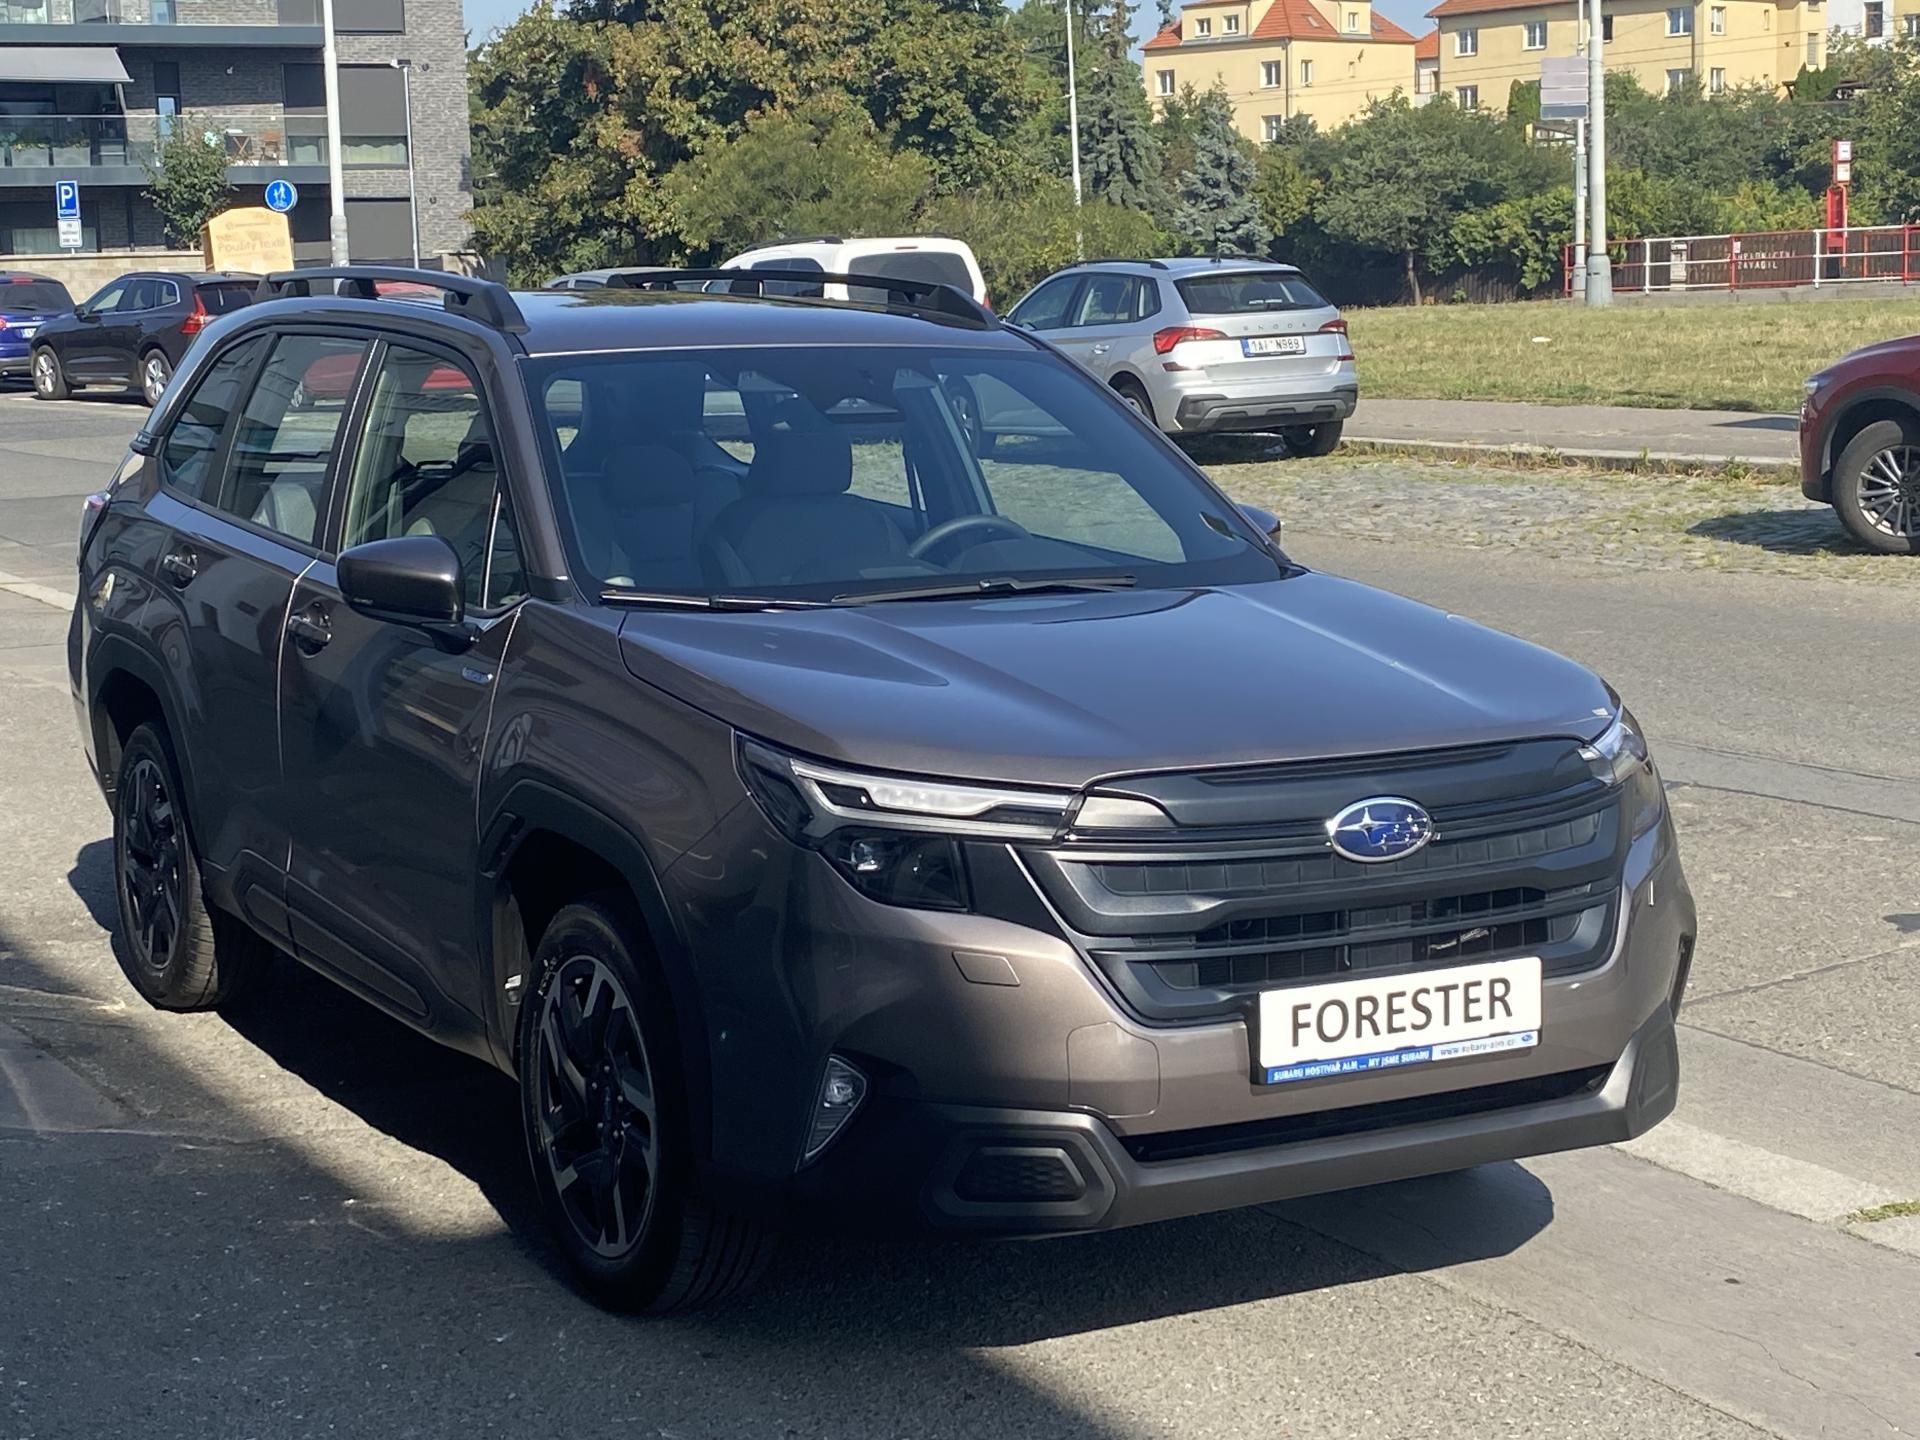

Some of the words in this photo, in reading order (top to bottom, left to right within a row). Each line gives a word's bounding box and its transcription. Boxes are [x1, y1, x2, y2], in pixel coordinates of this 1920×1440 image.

[60, 185, 73, 208] P
[1292, 977, 1513, 1048] FORESTER
[1273, 1070, 1304, 1081] SUBARU
[1342, 1060, 1358, 1070] ALM
[1368, 1057, 1381, 1066] MY
[1381, 1055, 1400, 1067] JSME
[1401, 1050, 1430, 1061] SUBARU
